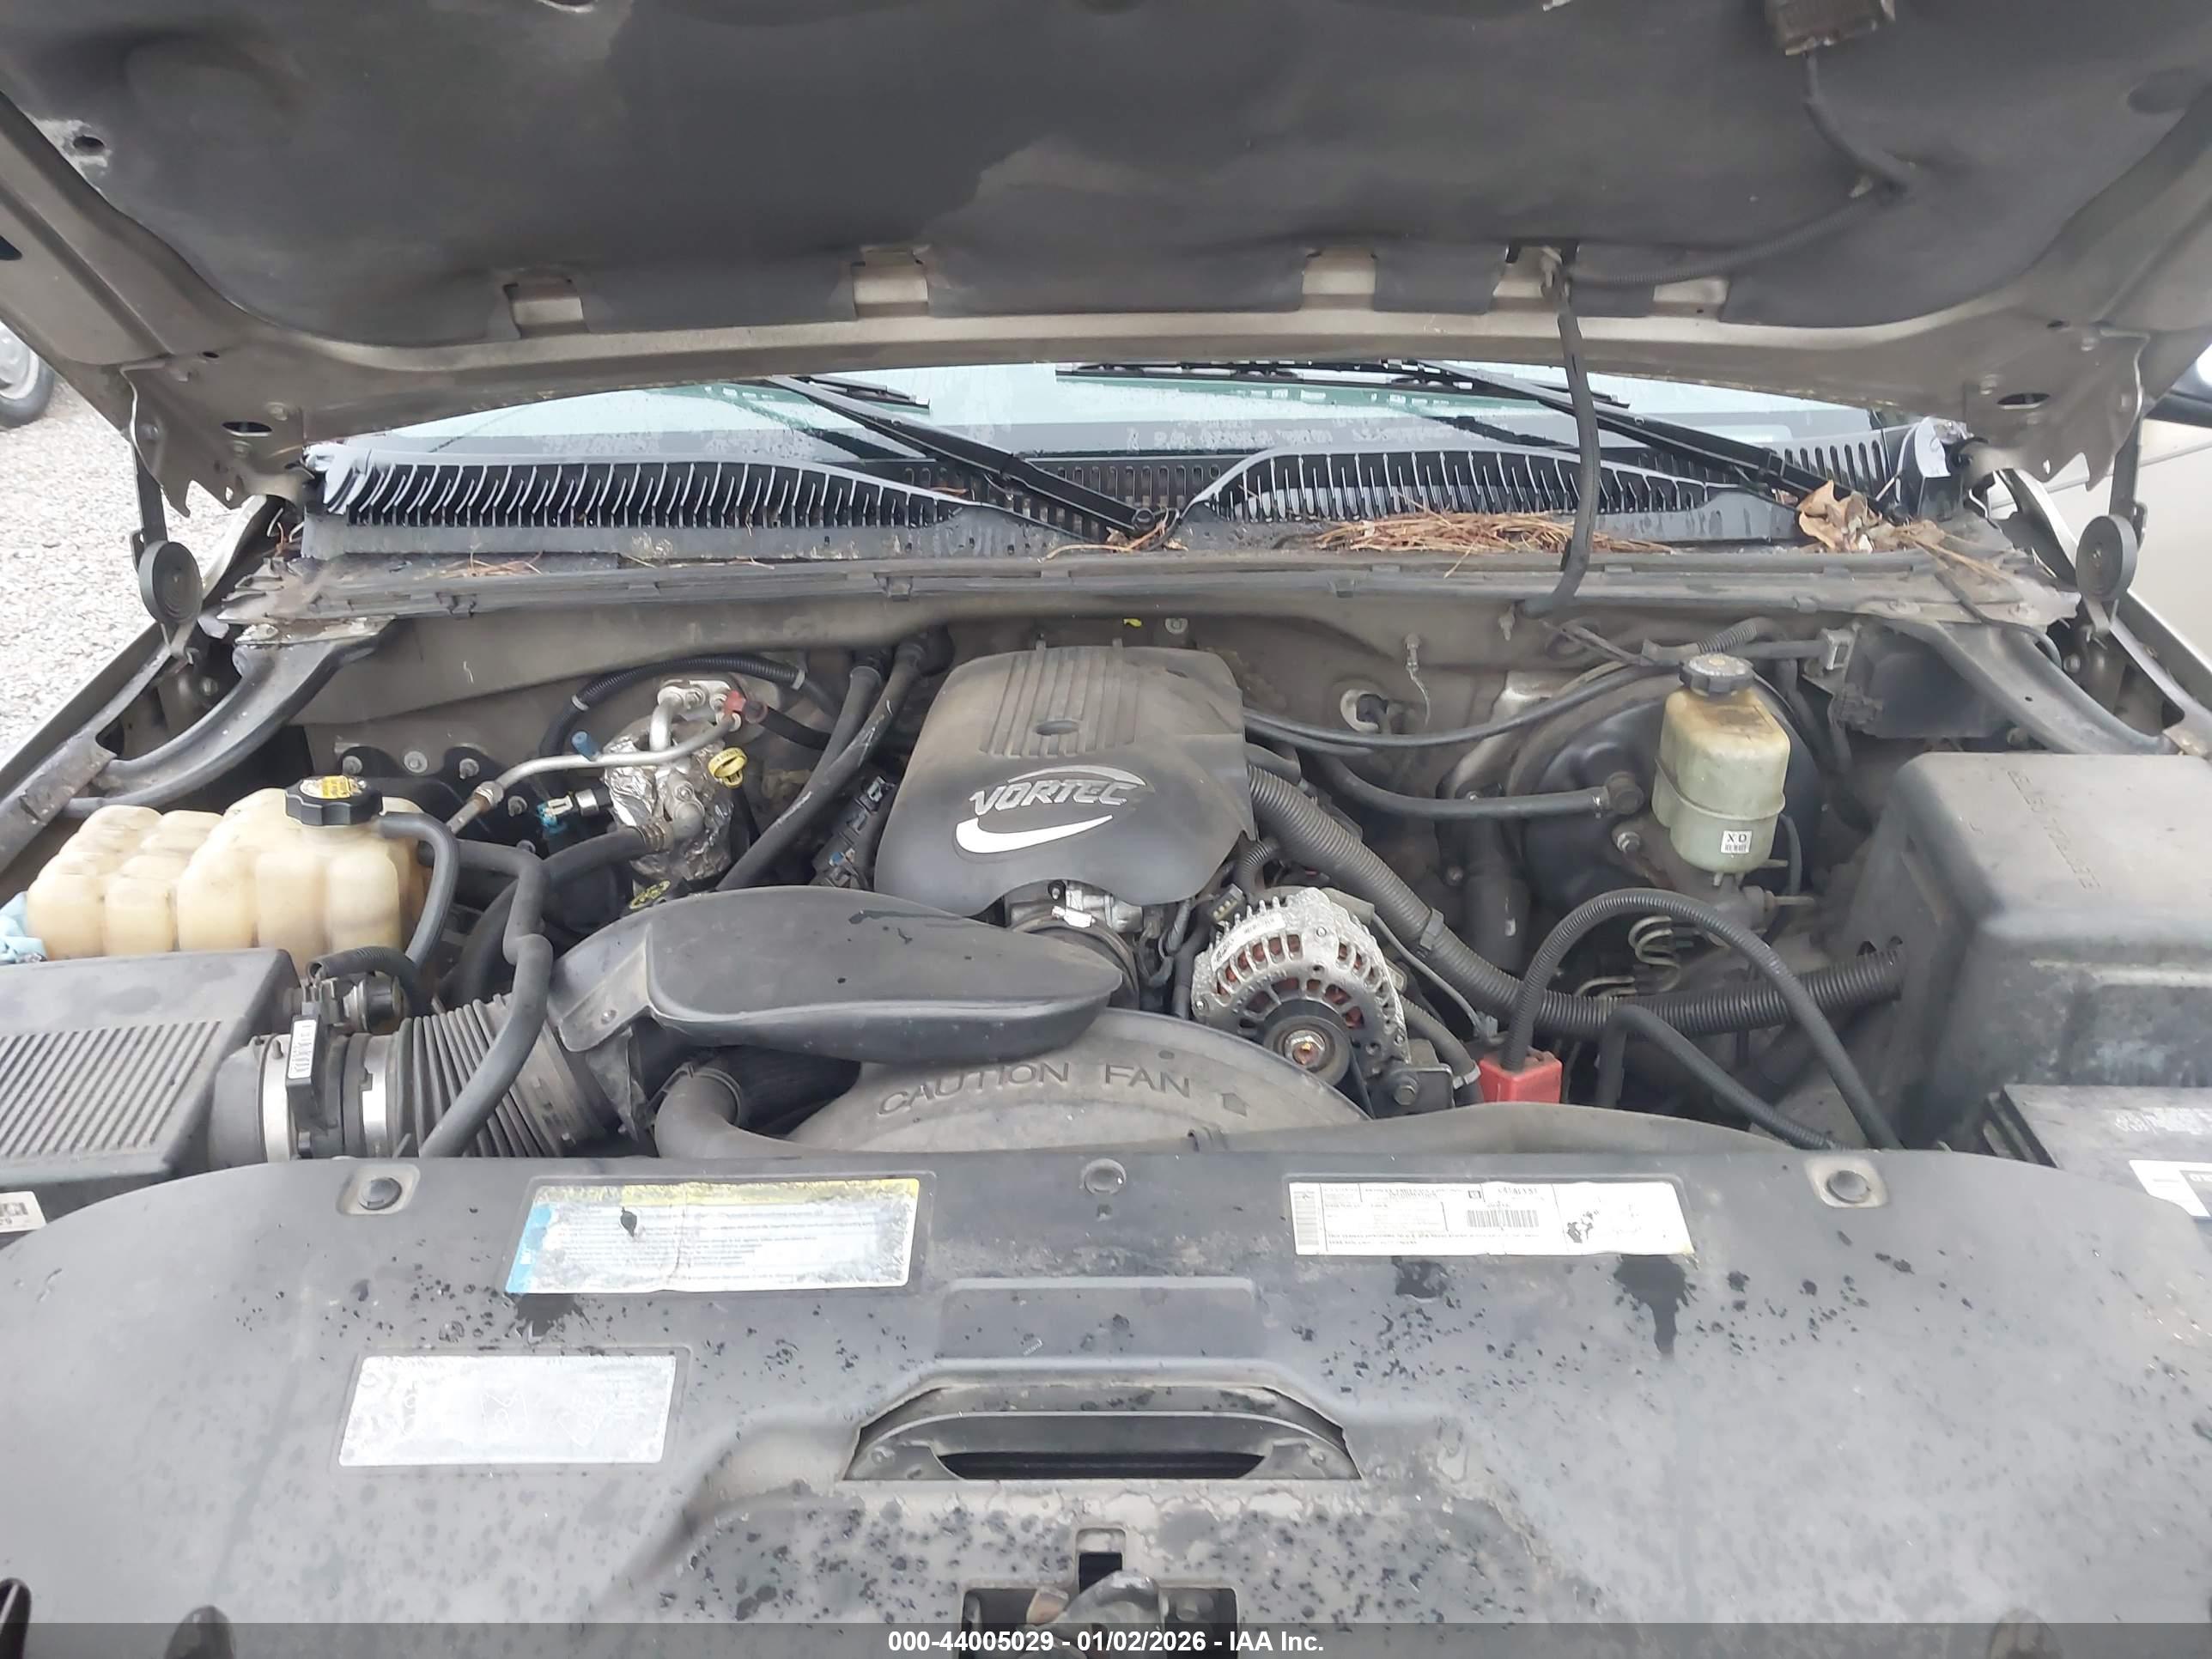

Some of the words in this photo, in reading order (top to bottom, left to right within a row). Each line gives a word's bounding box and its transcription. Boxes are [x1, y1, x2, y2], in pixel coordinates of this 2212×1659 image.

[969, 779, 1138, 816] VORTEC
[877, 1061, 1070, 1115] CAUTION
[1104, 1066, 1191, 1098] FAN
